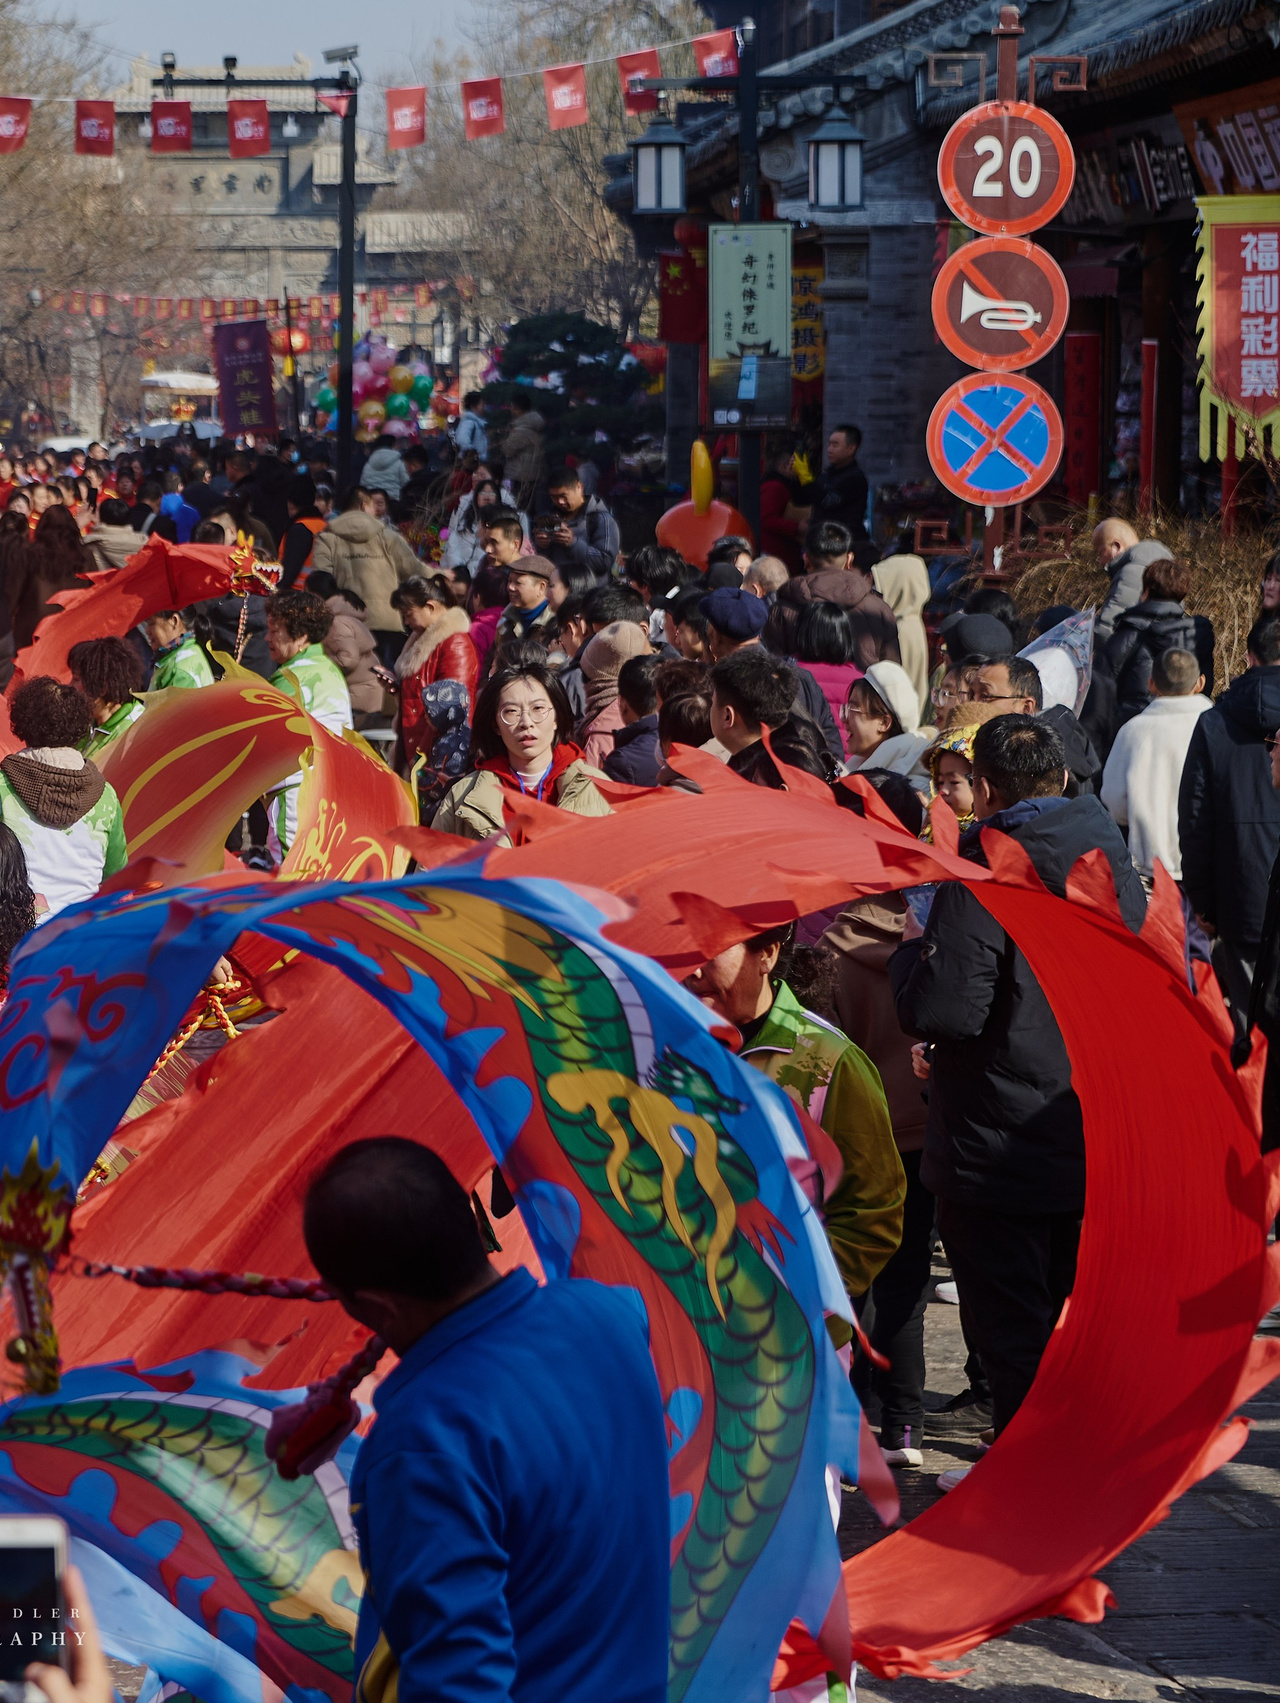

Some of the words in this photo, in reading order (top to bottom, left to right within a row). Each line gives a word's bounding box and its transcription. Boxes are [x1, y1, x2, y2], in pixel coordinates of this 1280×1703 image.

[972, 135, 1042, 198] 20
[741, 254, 759, 335] 奇幻侏罗纪
[1240, 231, 1280, 398] 福利彩票
[233, 368, 263, 427] 虎头鞋
